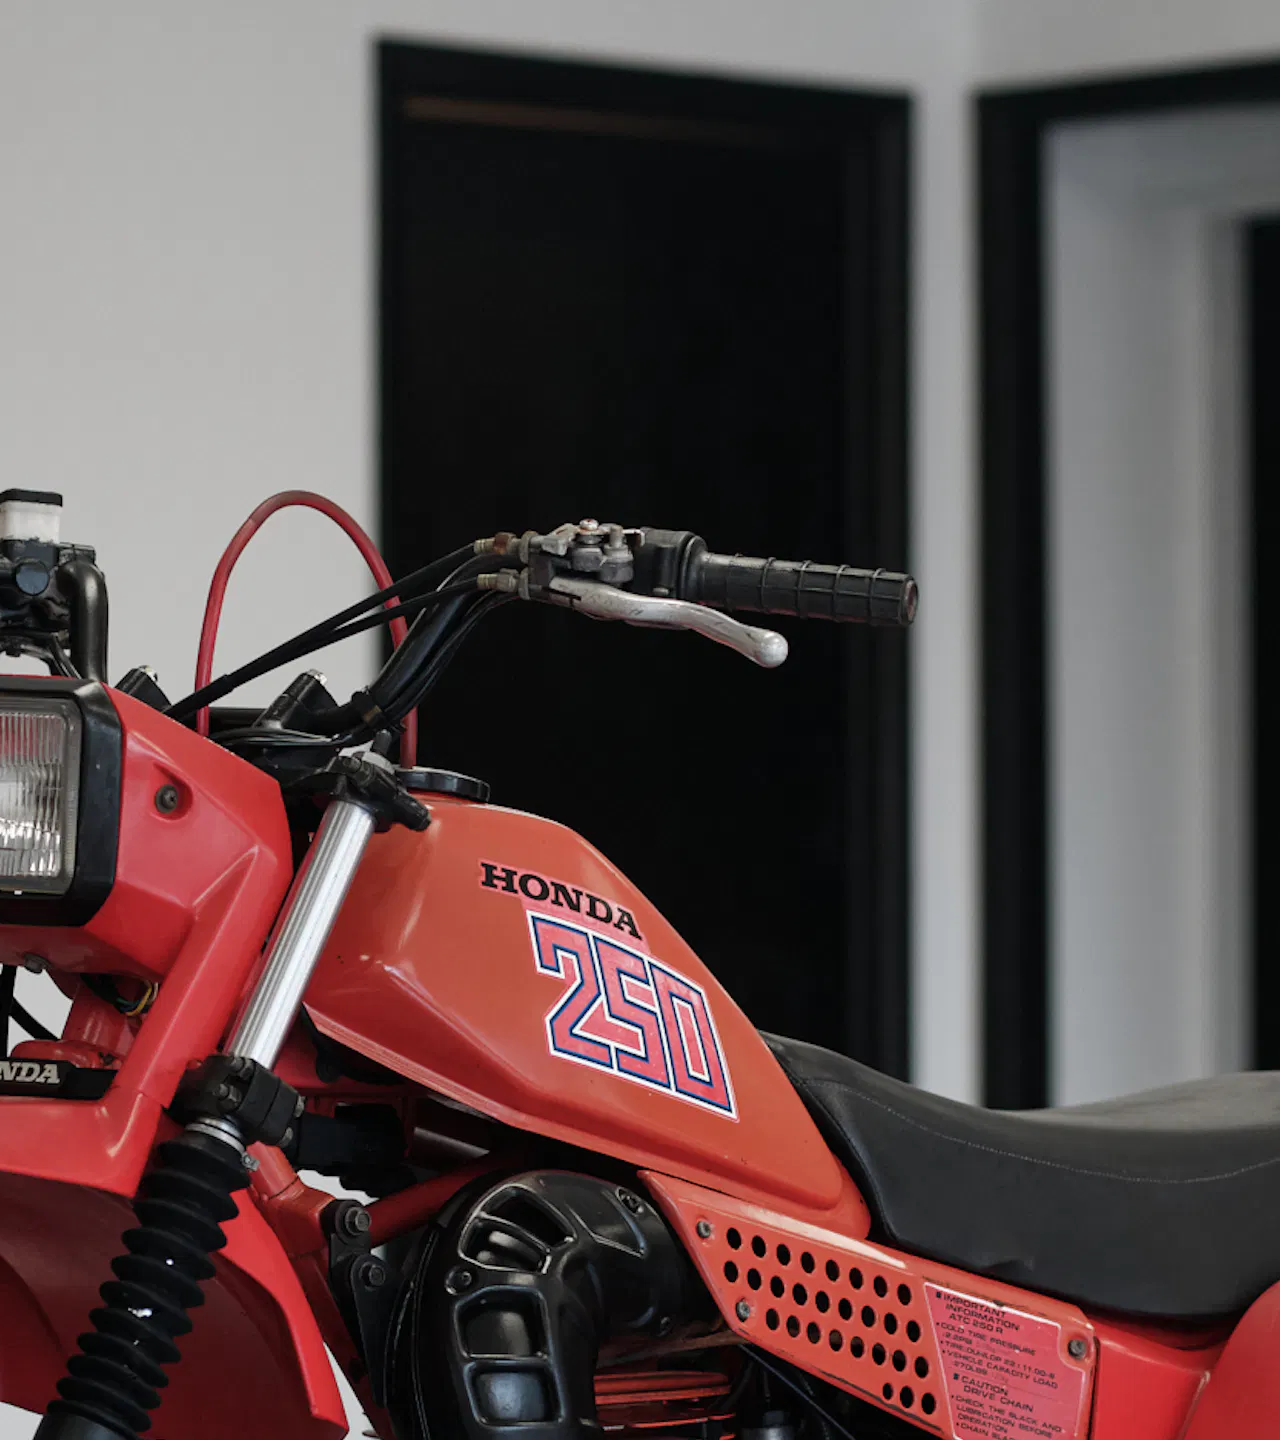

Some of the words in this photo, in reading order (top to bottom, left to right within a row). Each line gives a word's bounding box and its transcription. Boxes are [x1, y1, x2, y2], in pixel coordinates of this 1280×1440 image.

[480, 862, 643, 941] HONDA
[526, 909, 739, 1121] 250
[943, 1294, 1006, 1318] IMPORTANT
[946, 1304, 1019, 1330] INFORMATION
[949, 1313, 970, 1324] ATC
[972, 1320, 994, 1332] 250
[941, 1322, 965, 1334] COLD
[990, 1337, 1036, 1356] PRESSURE
[947, 1350, 983, 1365] VEHICLE
[987, 1362, 1029, 1379] CAPACITY
[1033, 1377, 1058, 1389] LOAD
[961, 1375, 1008, 1396] CAUTION
[964, 1385, 996, 1400] DRIVE
[1000, 1397, 1033, 1412] CHAIN
[956, 1395, 984, 1408] CHECK
[989, 1405, 1005, 1415] THE
[1042, 1422, 1062, 1433] AND
[956, 1405, 1015, 1427] LUBRICATION
[1019, 1423, 1052, 1439] BEFORE
[958, 1413, 1007, 1433] OPERATION
[960, 1423, 988, 1436] CHAIN
